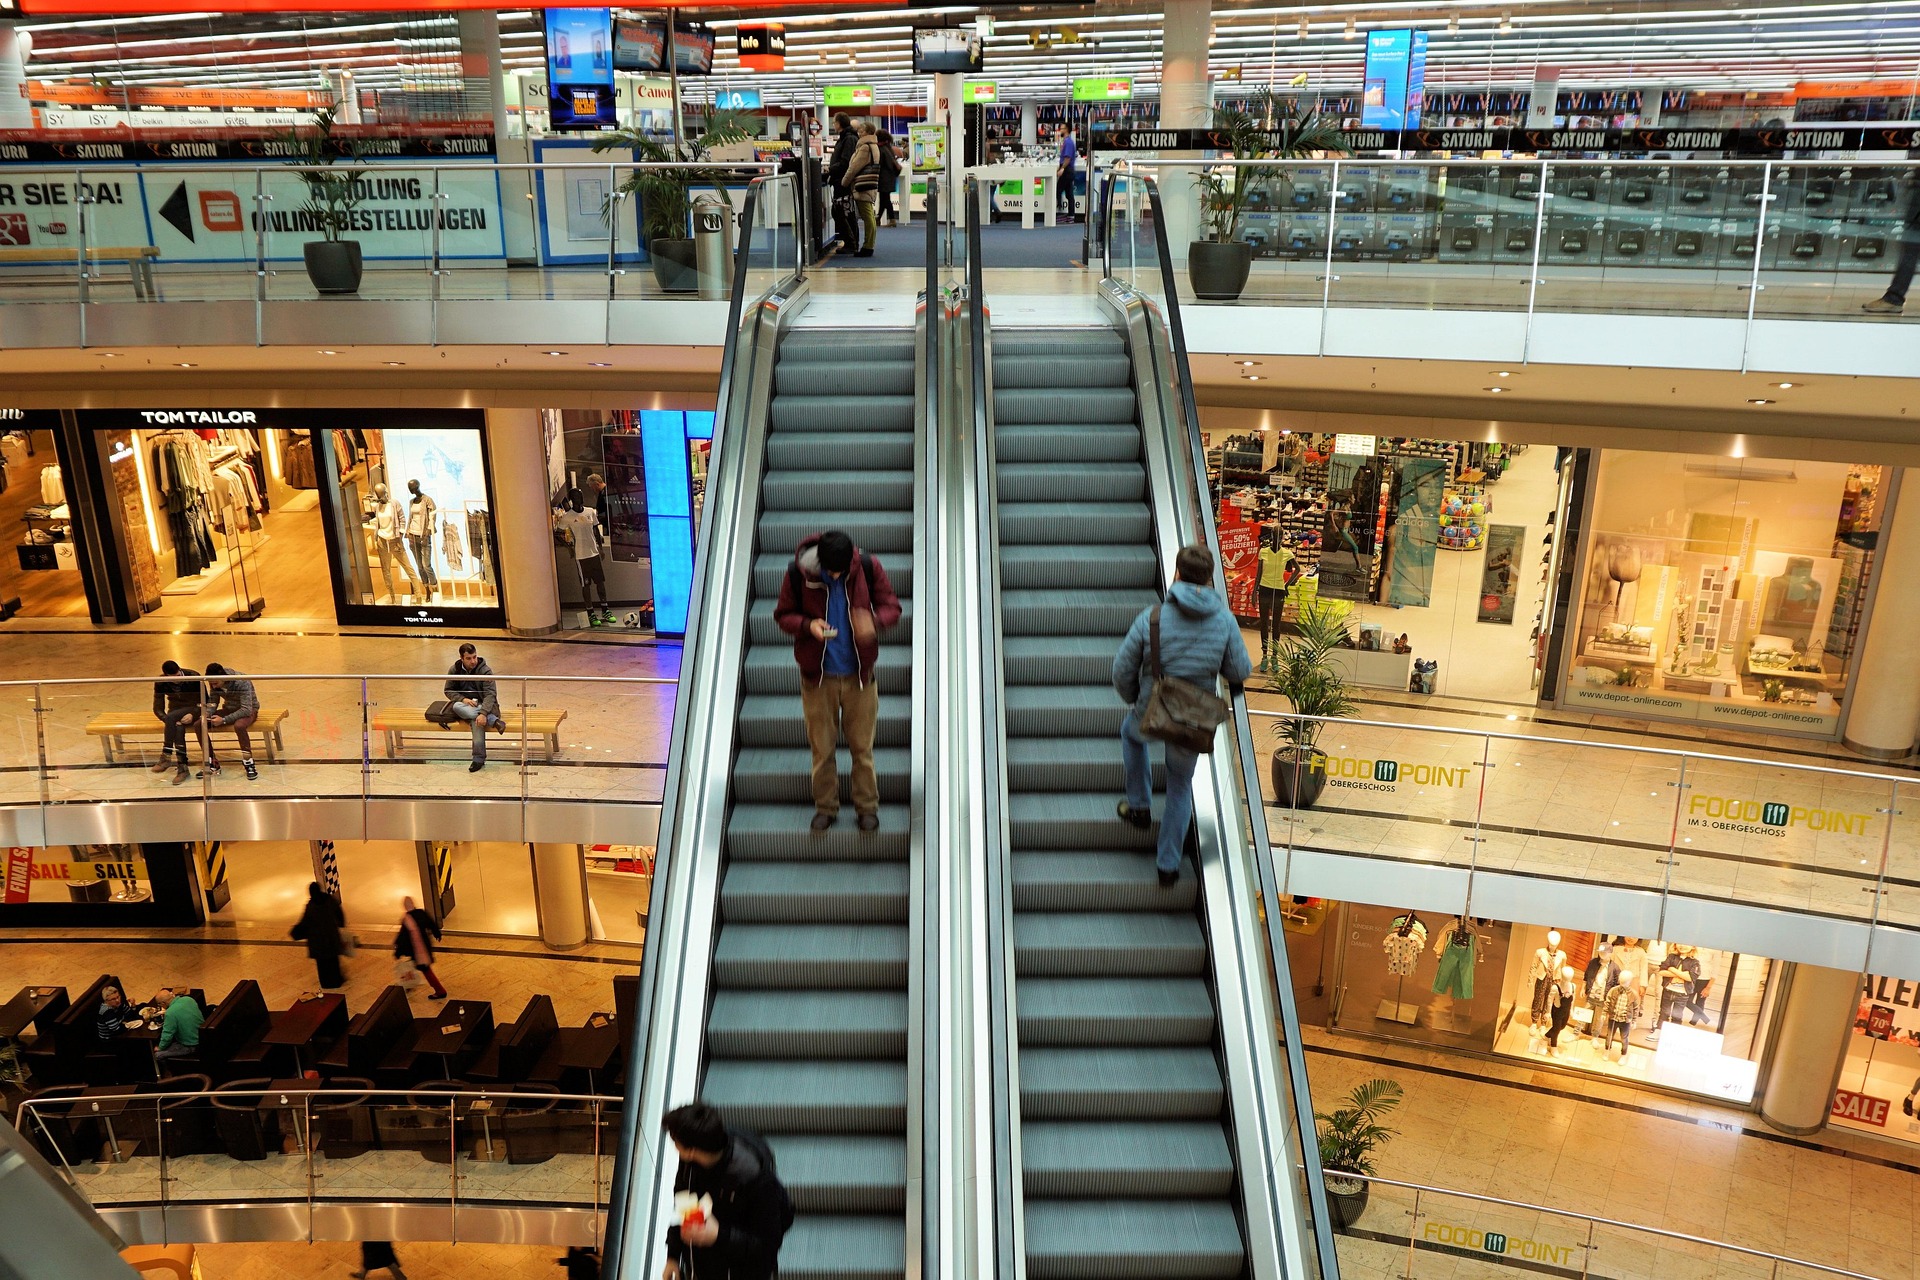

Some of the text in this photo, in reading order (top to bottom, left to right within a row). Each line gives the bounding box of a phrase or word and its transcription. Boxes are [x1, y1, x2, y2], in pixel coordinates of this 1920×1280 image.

[740, 36, 758, 49] Info
[770, 36, 785, 50] Info
[89, 114, 108, 126] ISY
[188, 118, 209, 126] belkin
[444, 138, 489, 154] SATURN
[1130, 132, 1178, 148] SATURN
[1442, 132, 1493, 148] SATURN
[1552, 132, 1606, 148] SATURN
[1666, 132, 1722, 148] SATURN
[1785, 131, 1845, 148] SATURN
[0, 144, 28, 159] URN
[76, 144, 124, 158] SATURN
[170, 142, 218, 158] SATURN
[22, 182, 68, 206] SIE
[1004, 200, 1038, 208] SAMSG
[38, 222, 67, 234] YouTube
[141, 411, 256, 424] TOM TAILOR
[1394, 518, 1430, 527] adidas
[1222, 541, 1256, 550] REDUZIERT!
[1578, 690, 1682, 708] www.depot-online.com
[1714, 704, 1823, 724] www.depot-online.com
[1310, 754, 1470, 788] FOOD POINT
[1330, 780, 1396, 793] OBERGESCHOSS
[1689, 794, 1872, 836] FOOD POINT
[1688, 818, 1786, 837] IM 3. OBERGESCHOSS
[10, 860, 28, 894] FINAL
[31, 864, 136, 879] SALE SALE
[1833, 1092, 1888, 1124] SALE
[1424, 1222, 1574, 1265] FOOD POINT
[1443, 1245, 1504, 1262] OBERGESCHOSS
